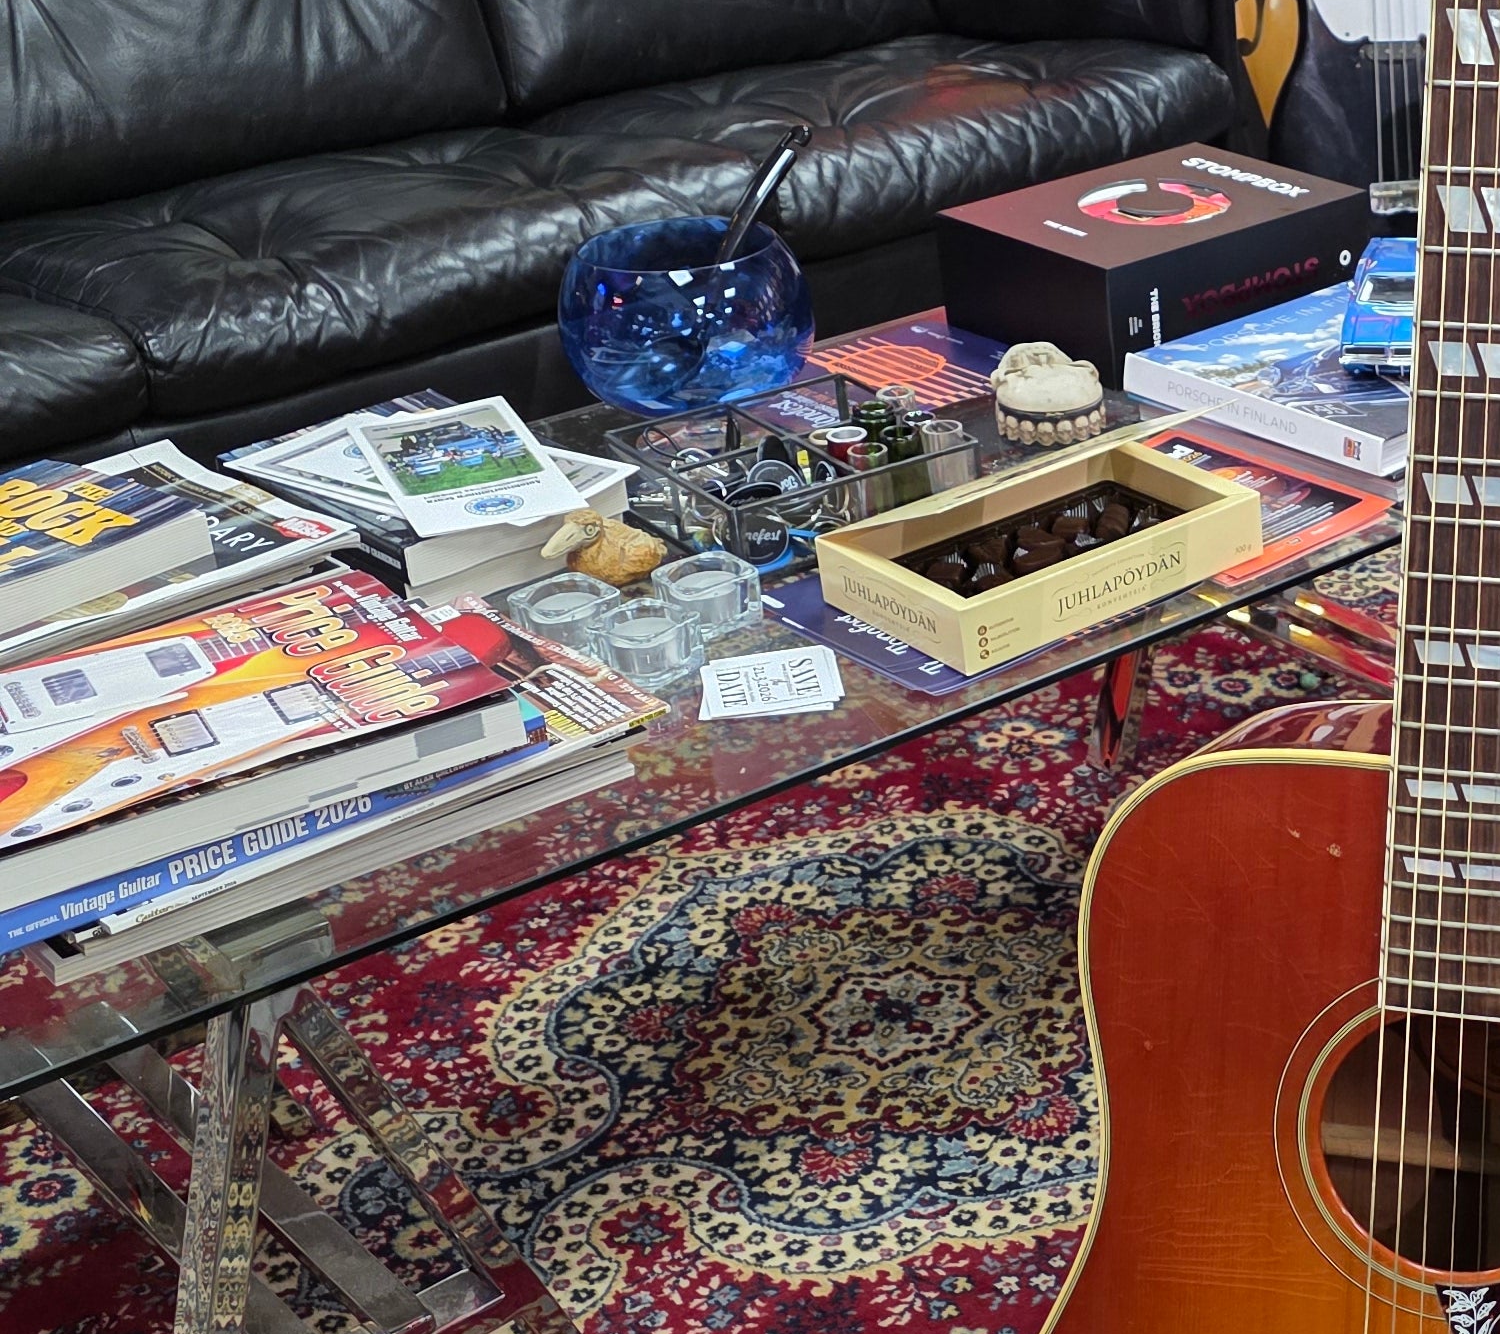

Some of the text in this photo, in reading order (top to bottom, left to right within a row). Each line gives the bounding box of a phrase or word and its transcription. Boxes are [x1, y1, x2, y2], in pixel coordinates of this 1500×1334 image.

[1182, 157, 1310, 198] STOMPBOX
[1197, 315, 1291, 351] PORSCHE
[1296, 304, 1322, 317] IN
[1167, 380, 1227, 411] PORSCHE
[1242, 406, 1298, 436] FINLAND
[0, 478, 140, 547] ROCK
[842, 575, 937, 635] JUHLAPÖYDÄN
[1057, 550, 1182, 617] JUHLAPÖYDÄN
[238, 584, 359, 657] Price
[306, 644, 450, 724] Guide
[788, 658, 822, 697] SAVE
[716, 669, 749, 708] DATE
[8, 793, 372, 939] THE OFFICIAL Vintage Guitar PRICE GUIDE 2026
[191, 884, 223, 901] SEPTEMBER
